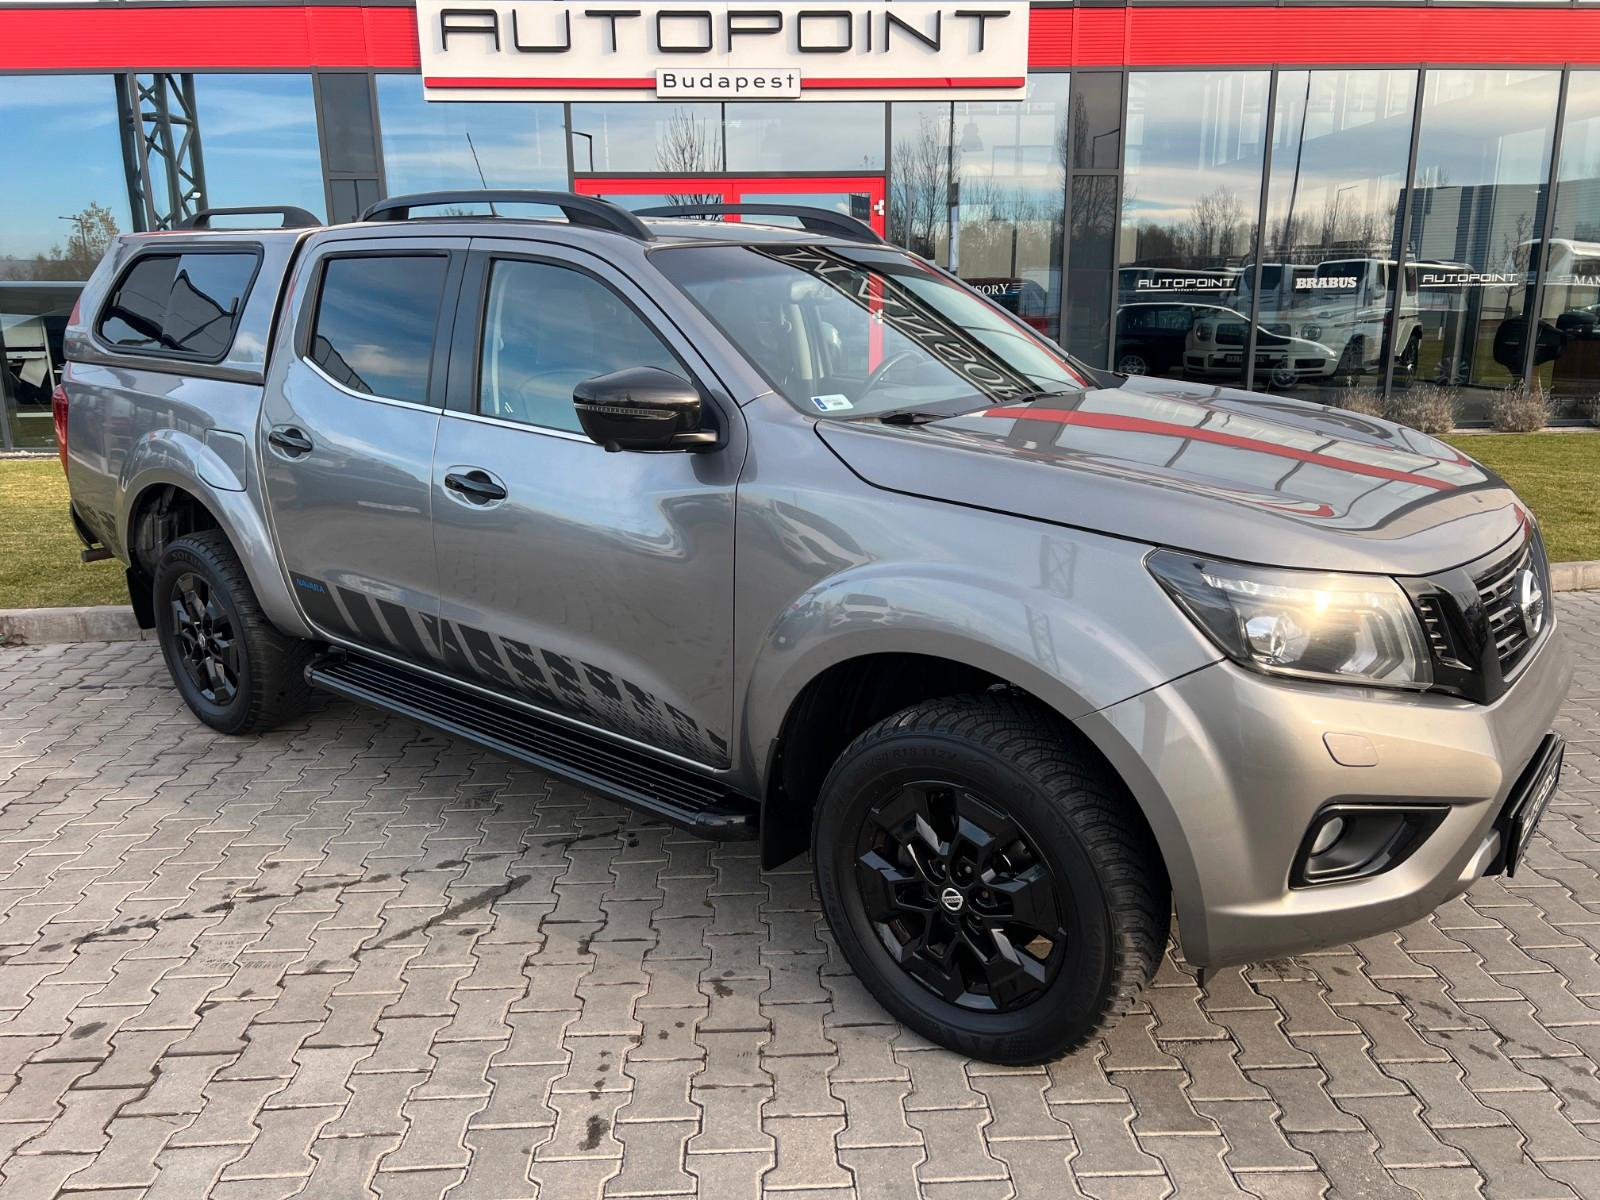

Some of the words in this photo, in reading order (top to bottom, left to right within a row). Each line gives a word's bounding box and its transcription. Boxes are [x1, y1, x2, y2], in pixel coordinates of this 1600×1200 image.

[439, 9, 1012, 53] AUTOPOINT
[662, 72, 796, 92] Budapest
[1138, 278, 1235, 288] AUTOPOINT
[1295, 276, 1357, 289] BRABUS
[1422, 273, 1518, 283] AUTOPOINT
[973, 283, 1009, 295] SORY
